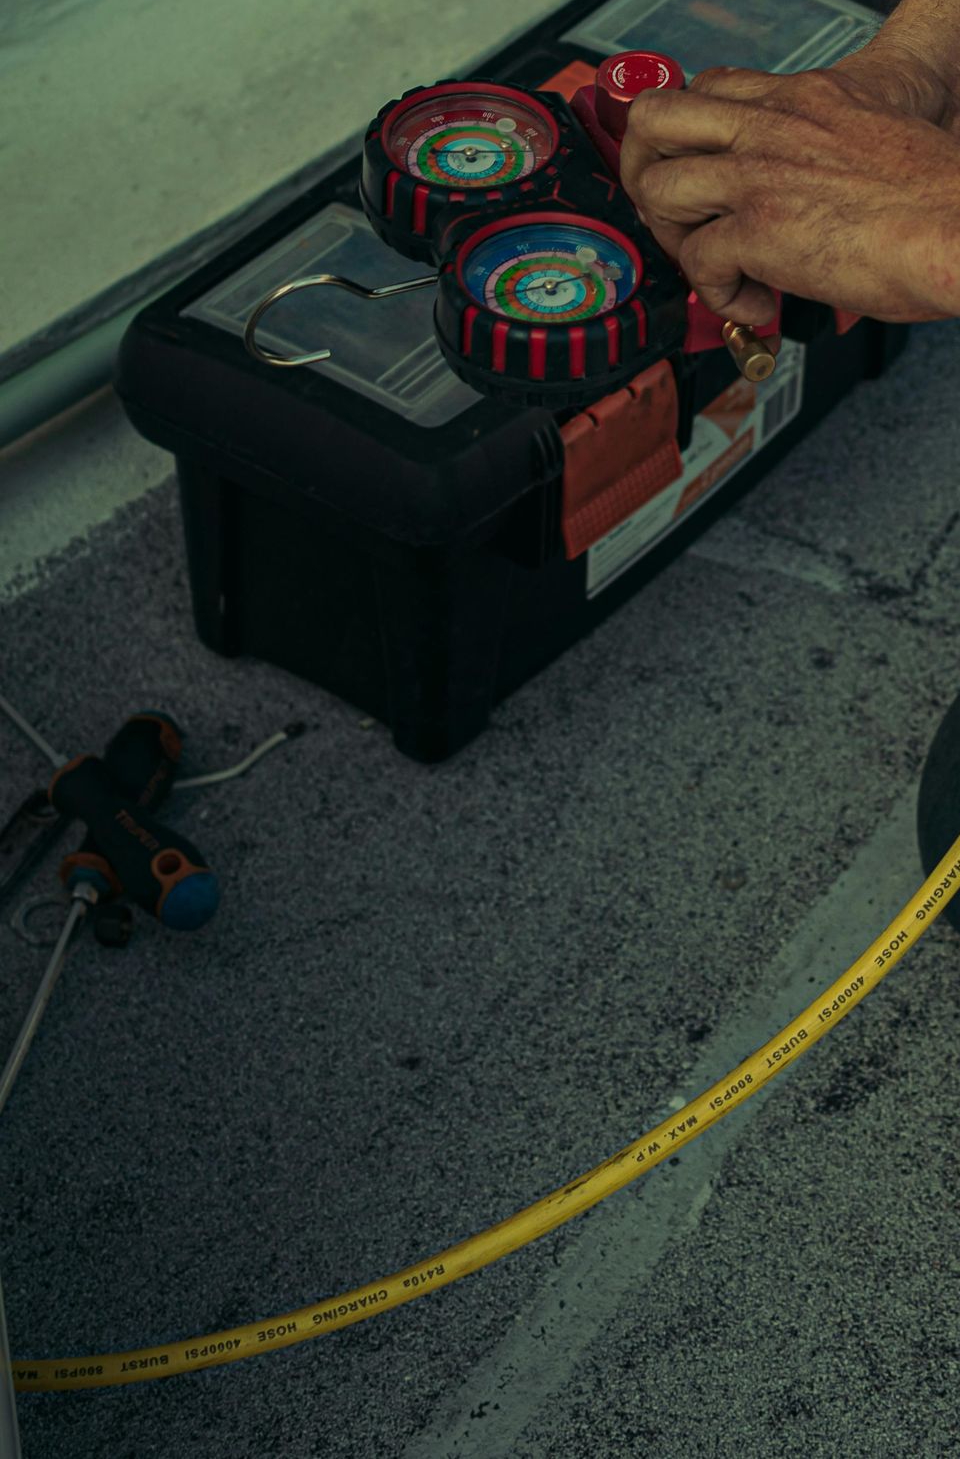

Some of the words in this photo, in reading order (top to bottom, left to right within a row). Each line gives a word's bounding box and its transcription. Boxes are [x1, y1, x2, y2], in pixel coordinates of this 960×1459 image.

[874, 930, 909, 968] HOSE
[817, 975, 865, 1023] 4000PSI
[765, 1029, 809, 1069] BURST
[709, 1073, 754, 1111] 800PSI
[663, 1115, 698, 1141] MAX.
[631, 1141, 661, 1163] W.P.
[402, 1264, 446, 1288] R410a
[311, 1289, 388, 1325] CHARGING
[257, 1322, 297, 1342] HOSE
[185, 1338, 242, 1361] 4000PSI
[54, 1365, 104, 1379] 800PSI
[120, 1354, 169, 1372] BURST
